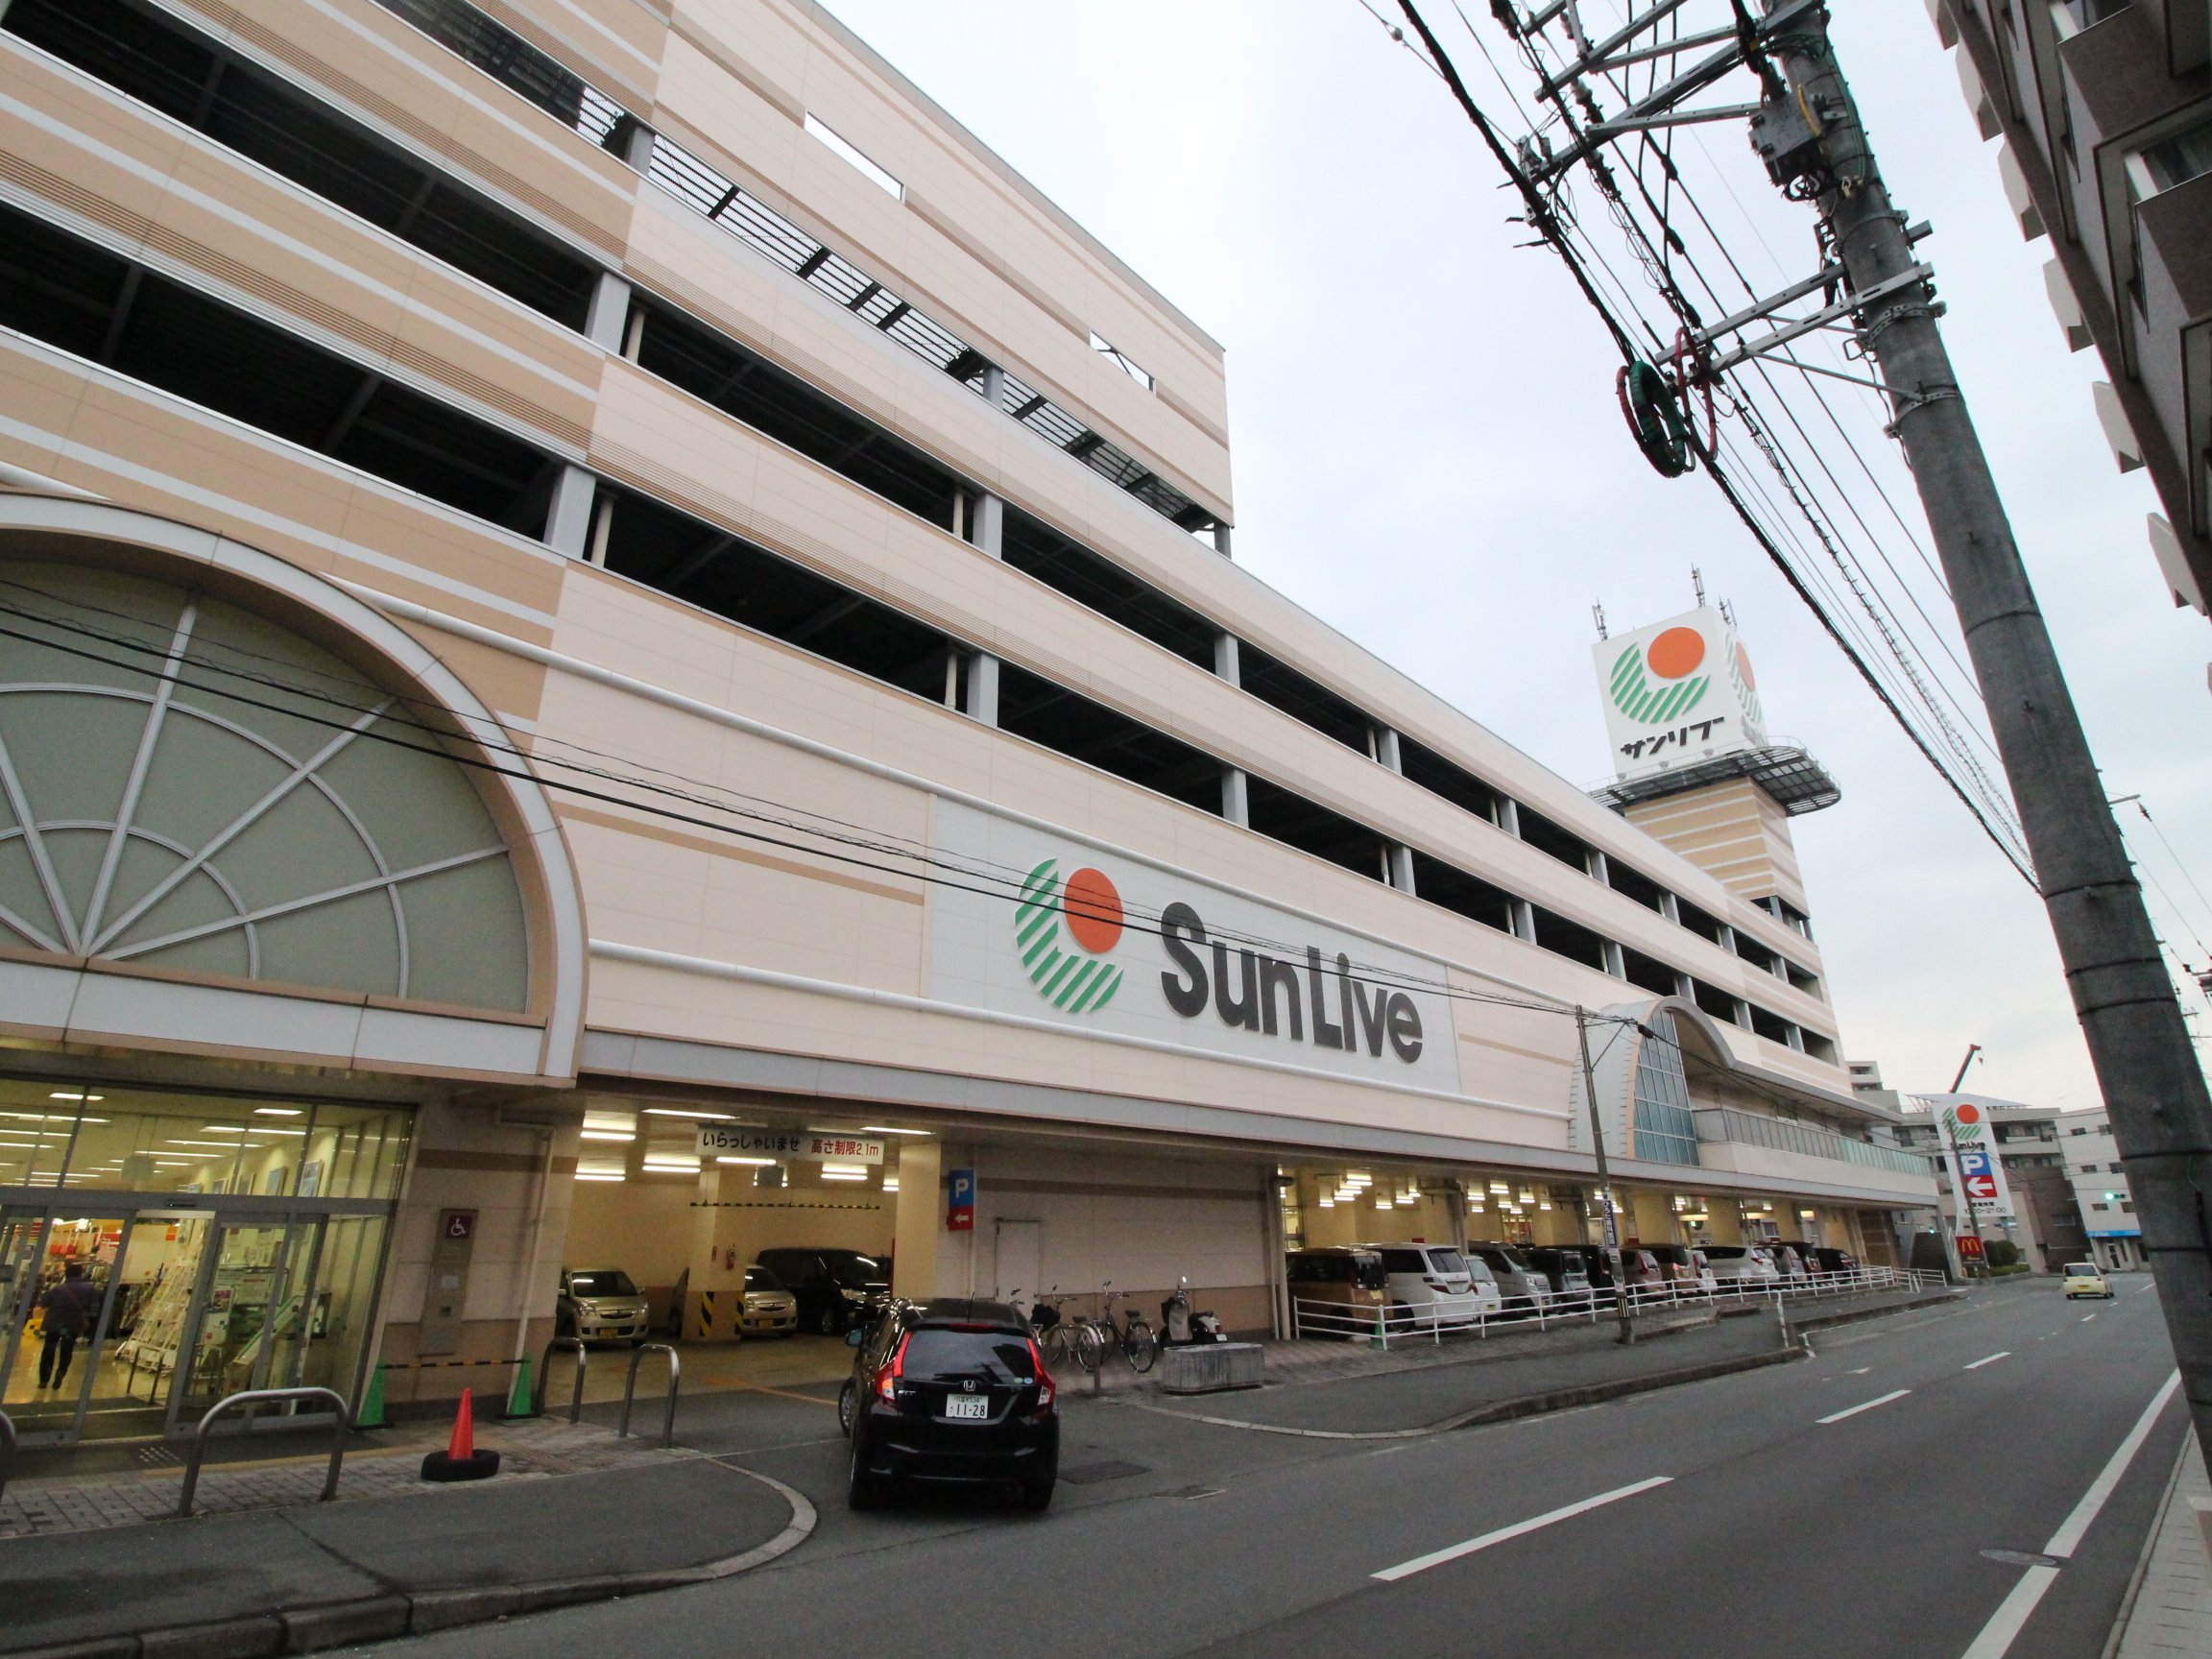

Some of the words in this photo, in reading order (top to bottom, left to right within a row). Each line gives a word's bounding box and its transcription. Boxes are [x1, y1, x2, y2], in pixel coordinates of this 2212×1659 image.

[1160, 901, 1424, 1064] SunLive
[703, 1132, 801, 1152] いらっしゃいませ
[810, 1139, 879, 1157] 高さ制限2.1m
[1960, 1155, 1984, 1174] P
[955, 1178, 970, 1199] P
